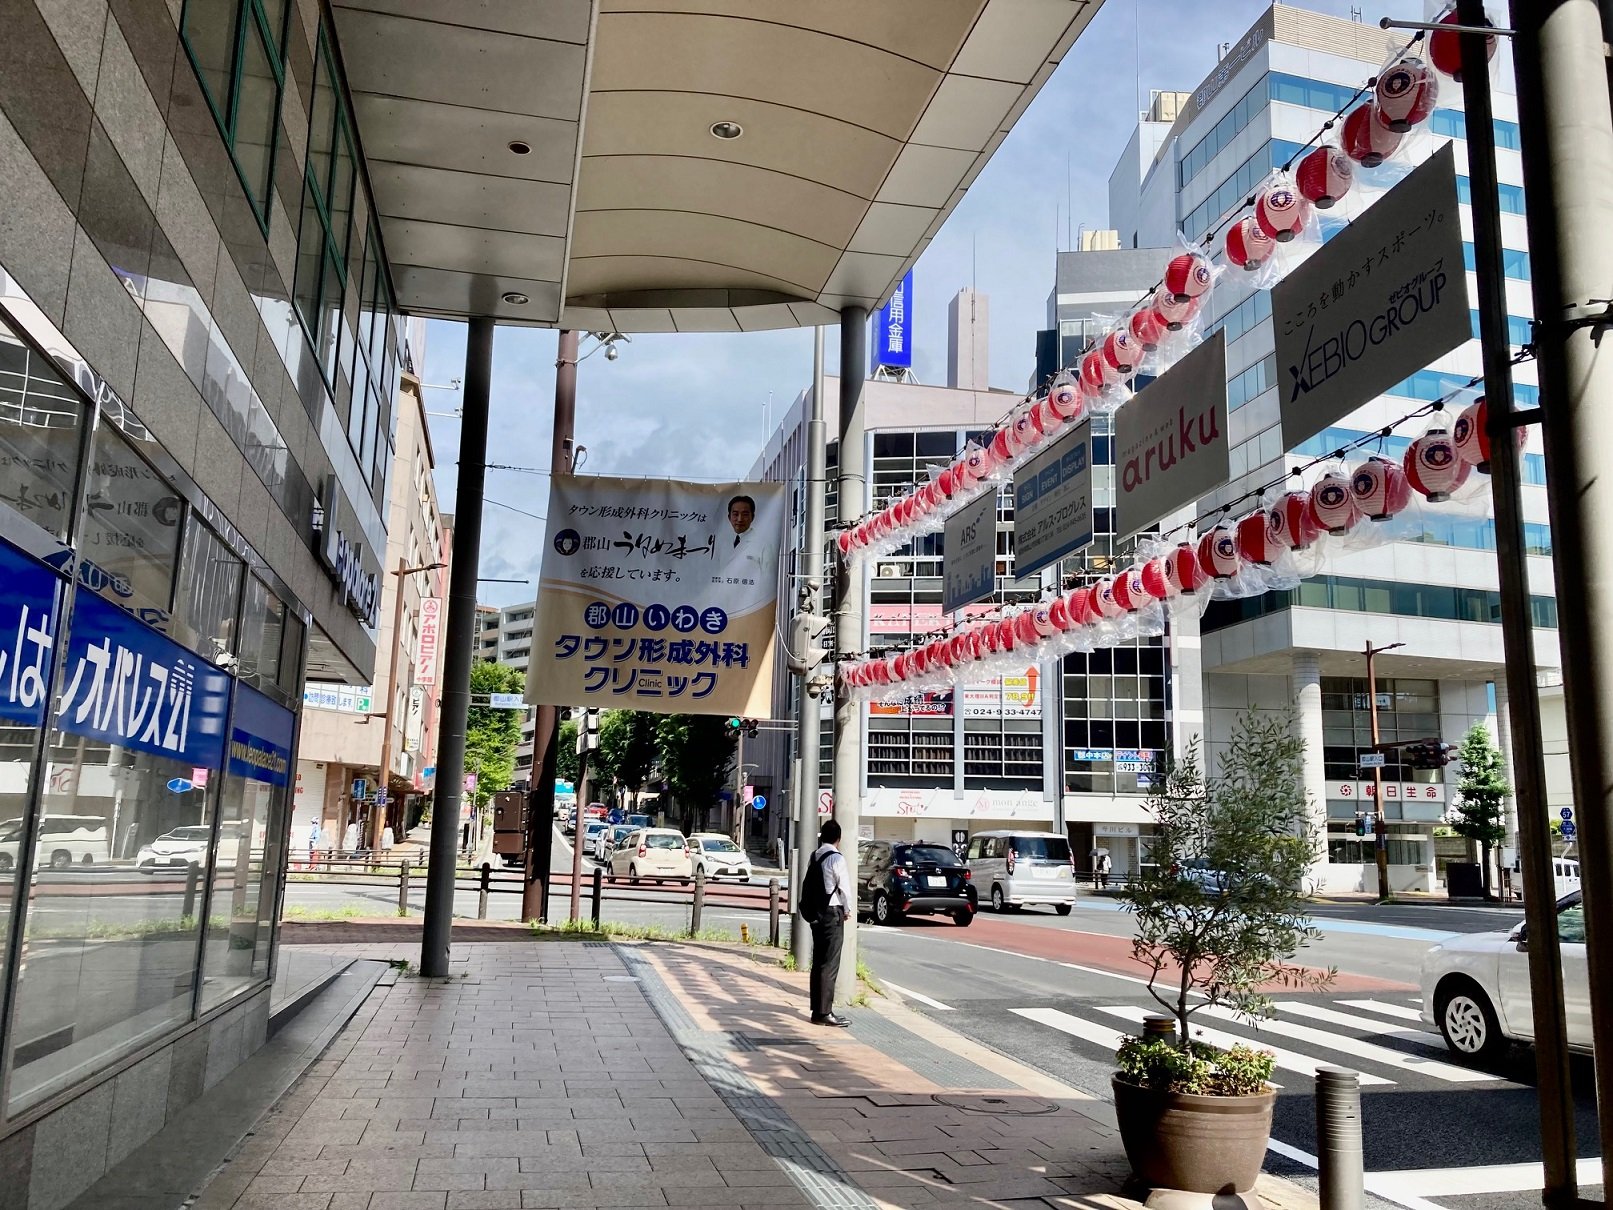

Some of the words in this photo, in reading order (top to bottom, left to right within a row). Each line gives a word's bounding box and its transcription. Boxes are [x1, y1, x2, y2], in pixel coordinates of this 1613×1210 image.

[1284, 208, 1446, 337] こころを動かすスポーツ。
[888, 281, 904, 353] 信用金庫
[1288, 319, 1369, 403] XEBIO
[1369, 272, 1447, 346] GROUP
[1122, 405, 1220, 493] aruku
[1041, 473, 1058, 491] EVENT
[1062, 457, 1086, 478] DISPLAY
[568, 503, 707, 523] タウン形成外科クリニックは
[960, 522, 977, 546] ARS
[580, 566, 682, 583] を応援しています。
[586, 604, 724, 634] 郡山いわき
[555, 634, 750, 669] タウン形成外科
[584, 666, 719, 699] クリニック
[638, 678, 663, 688] Clinic
